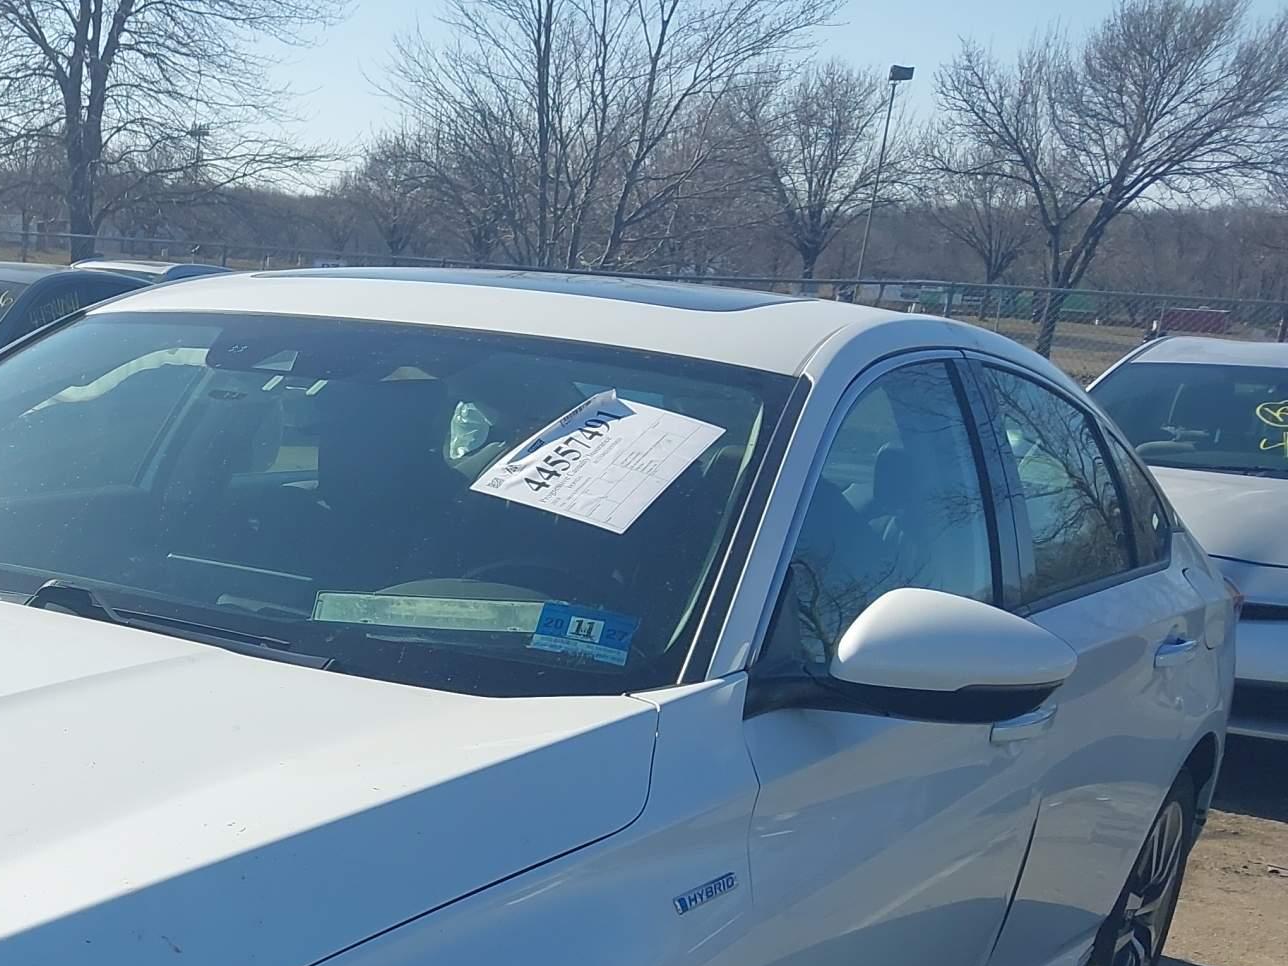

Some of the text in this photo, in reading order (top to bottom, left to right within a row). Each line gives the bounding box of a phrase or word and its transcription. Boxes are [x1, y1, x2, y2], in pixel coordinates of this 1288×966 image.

[524, 410, 623, 492] 44557491
[571, 619, 596, 639] 11
[687, 876, 736, 908] HYBRID
